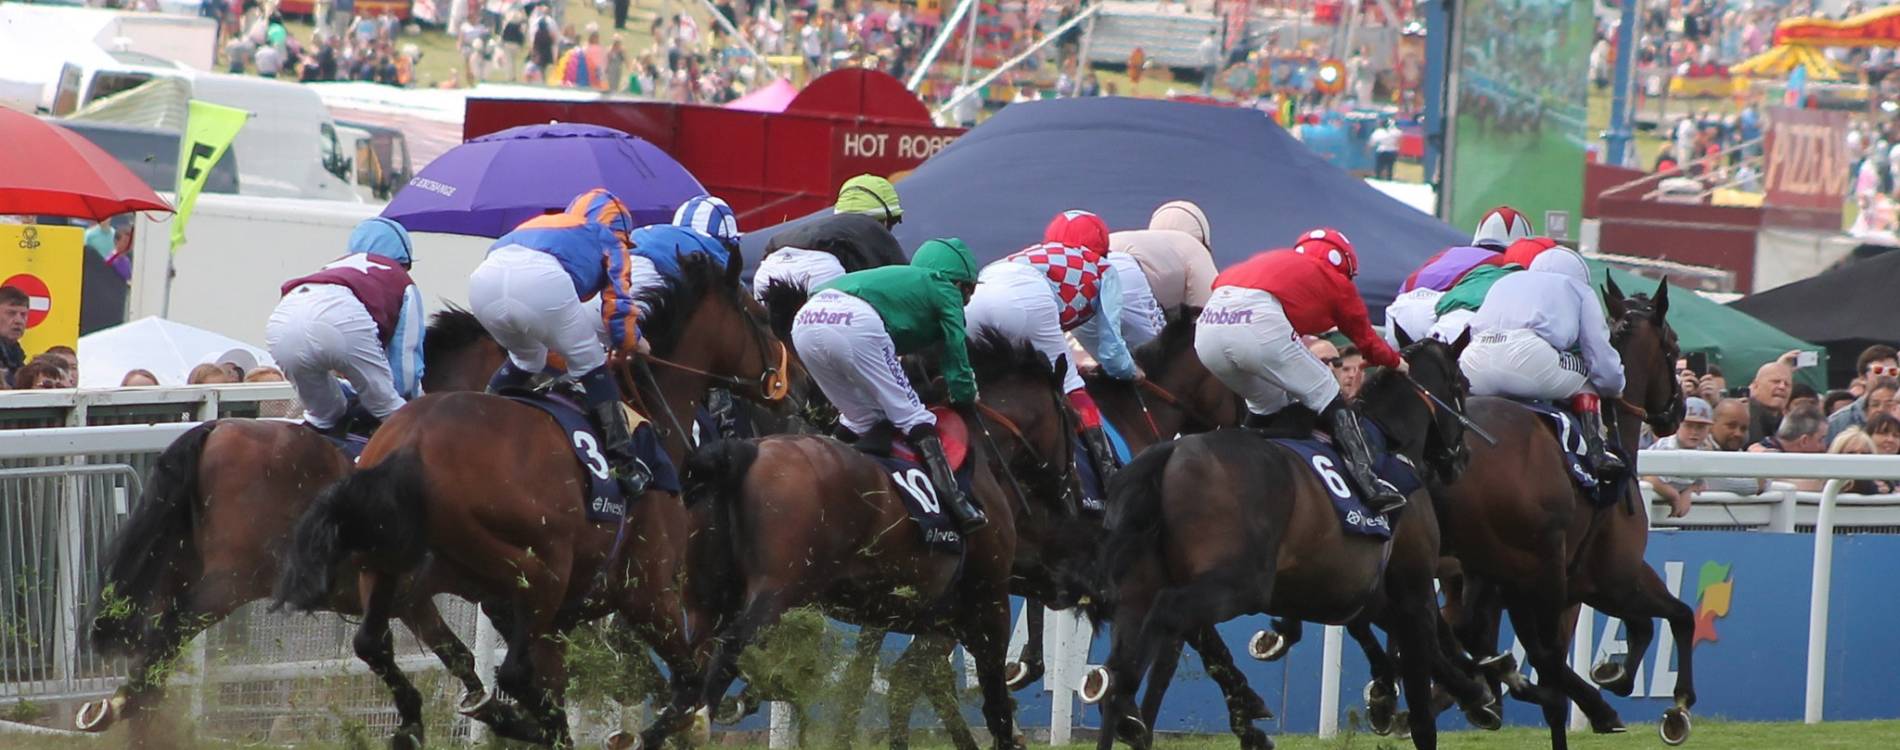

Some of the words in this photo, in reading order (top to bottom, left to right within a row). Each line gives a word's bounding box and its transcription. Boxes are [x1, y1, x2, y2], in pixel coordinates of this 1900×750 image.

[844, 133, 889, 157] HOT
[573, 430, 609, 480] 3
[1312, 455, 1351, 498] 6
[893, 468, 940, 514] 10
